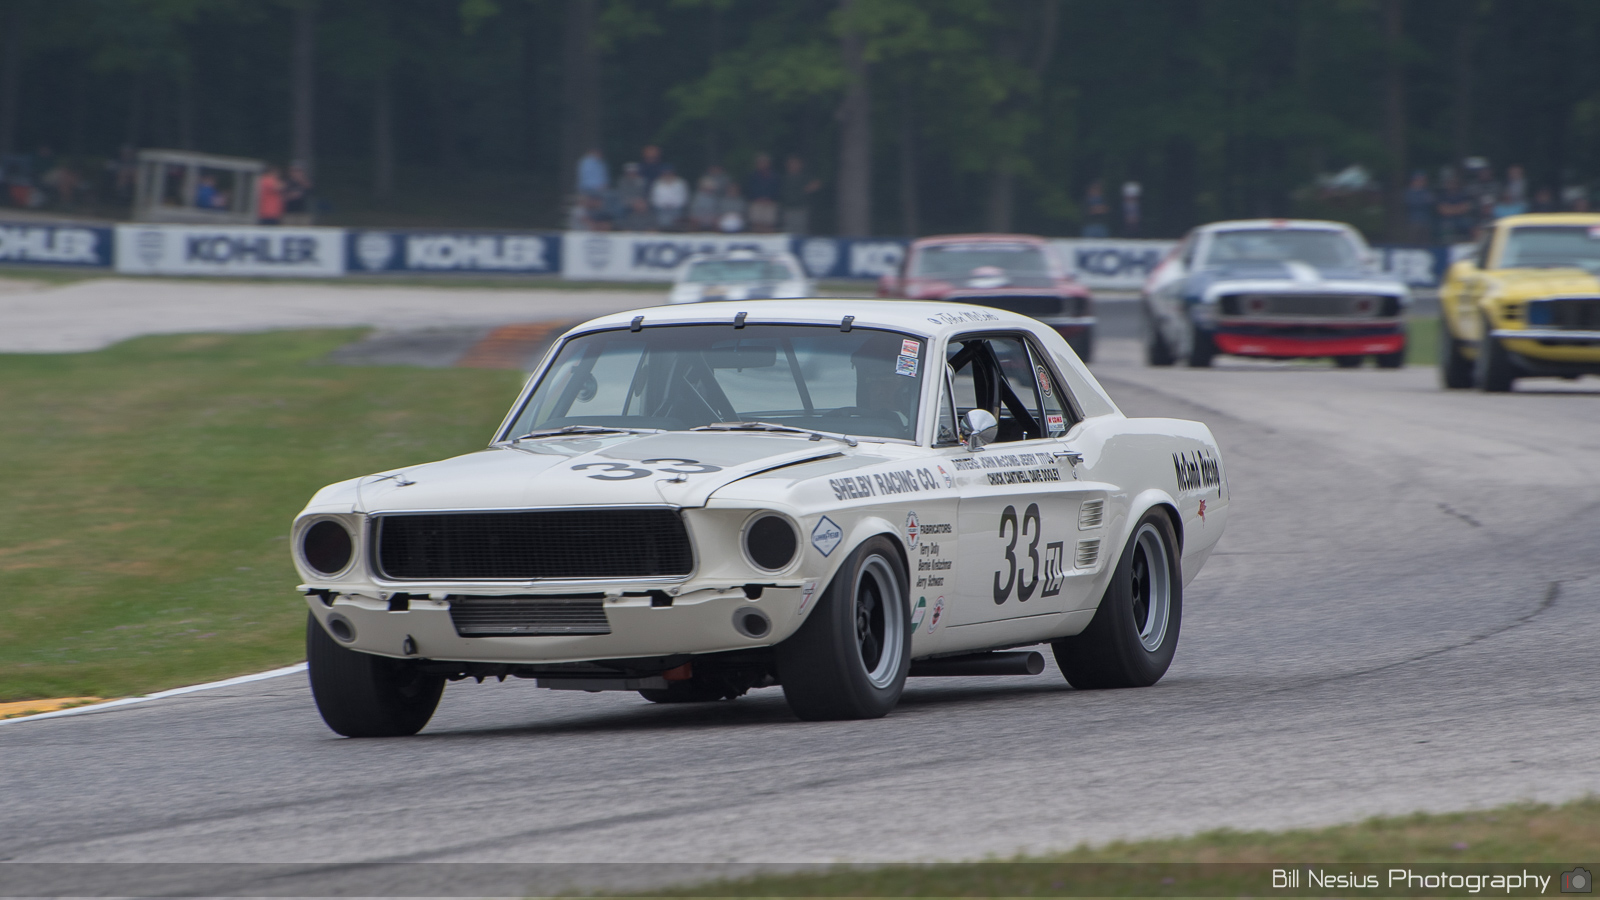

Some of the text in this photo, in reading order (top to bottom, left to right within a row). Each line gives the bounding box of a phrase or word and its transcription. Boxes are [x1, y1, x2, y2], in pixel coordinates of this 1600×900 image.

[186, 235, 321, 266] KOHLER
[405, 235, 548, 270] KOHLER
[570, 458, 723, 481] 33
[829, 467, 941, 501] SHELBY RACING CO.
[993, 503, 1041, 606] 33
